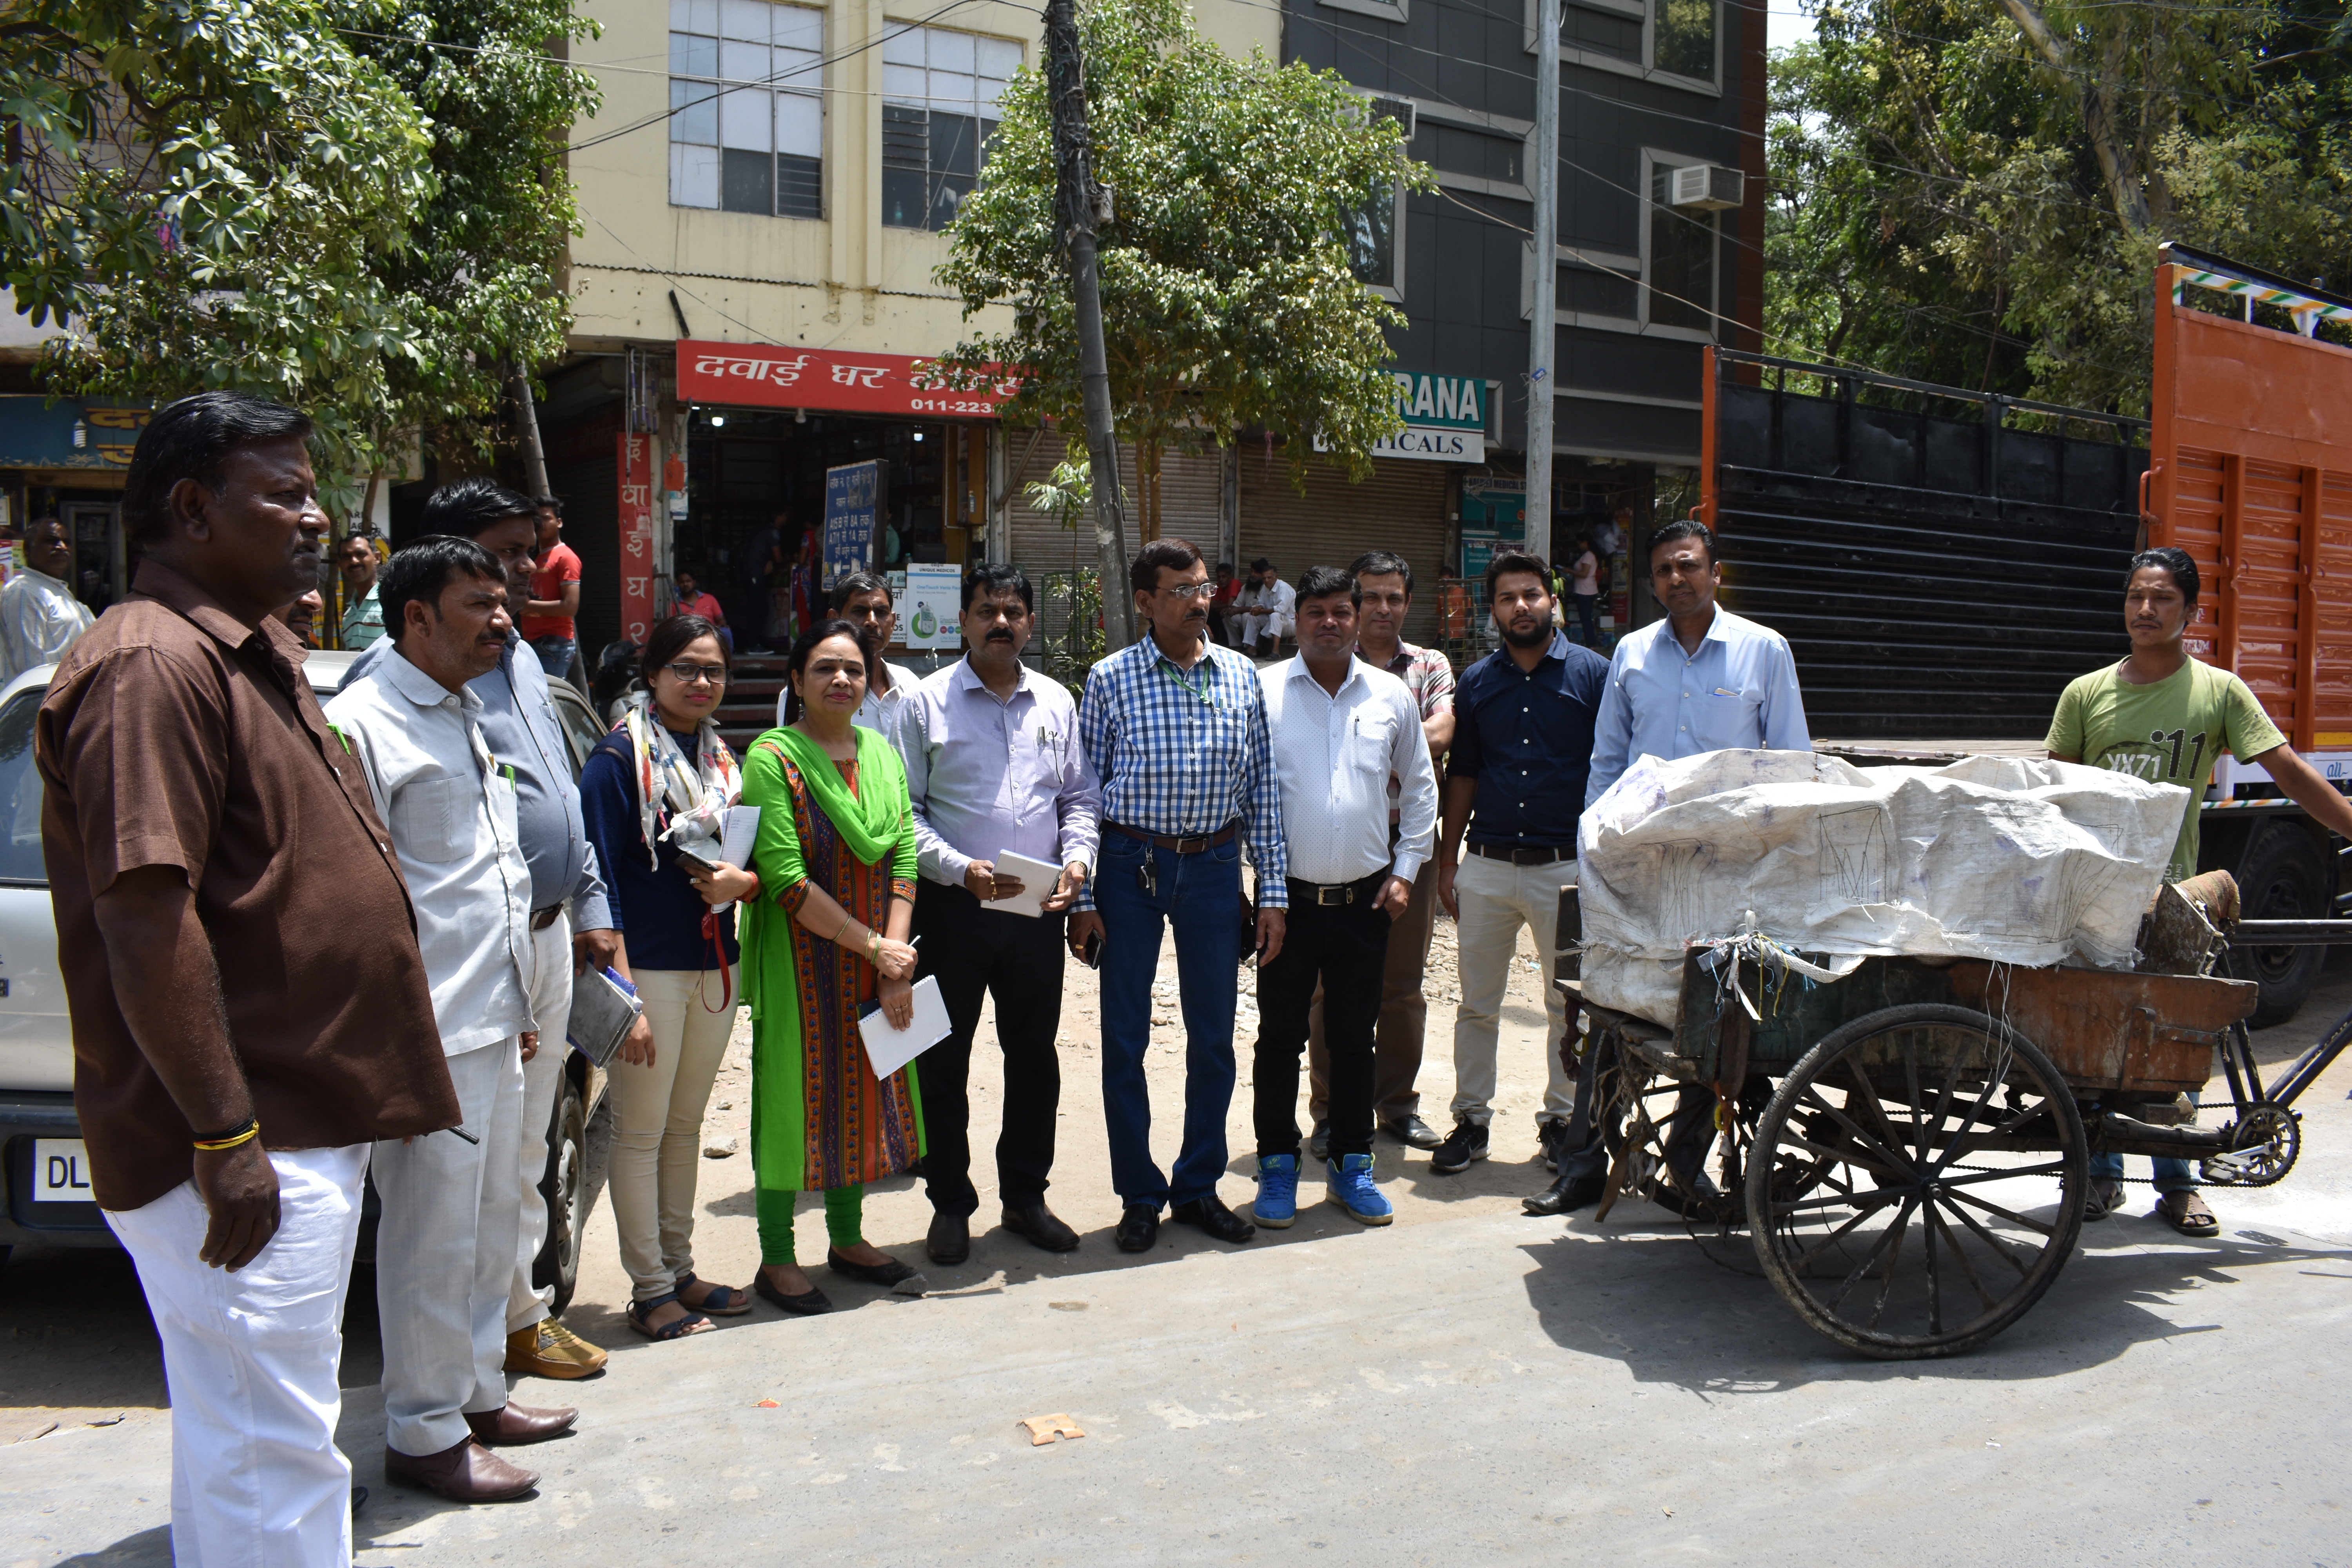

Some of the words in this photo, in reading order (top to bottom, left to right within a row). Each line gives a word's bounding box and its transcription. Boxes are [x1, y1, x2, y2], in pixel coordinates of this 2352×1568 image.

[695, 355, 810, 386] दवाई
[831, 365, 890, 388] घर
[1388, 372, 1479, 421] RANA
[1494, 479, 1519, 490] MEDICAL
[48, 1156, 90, 1189] DL
